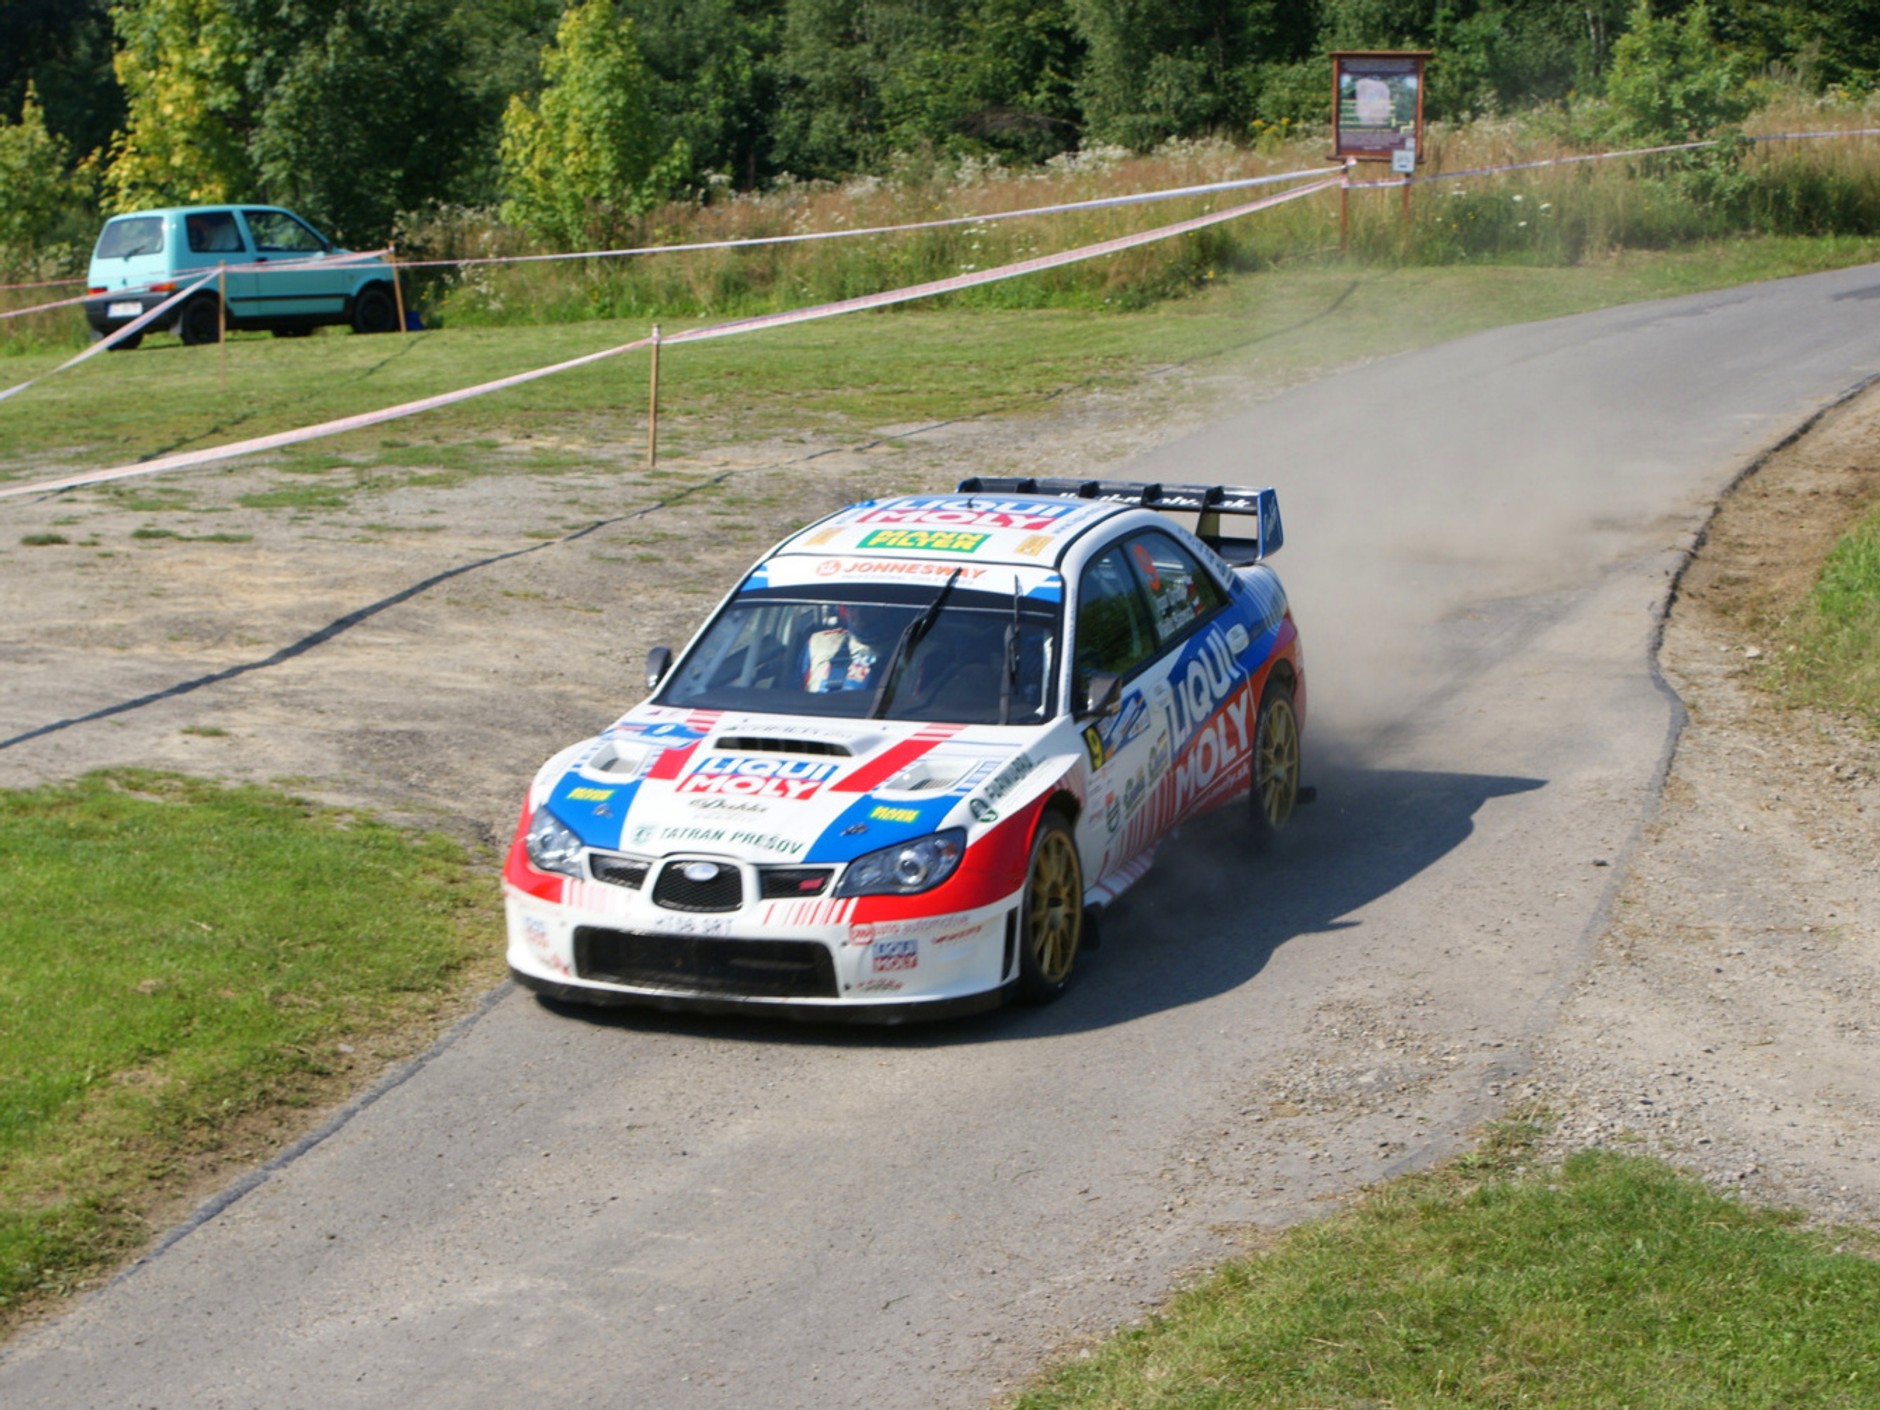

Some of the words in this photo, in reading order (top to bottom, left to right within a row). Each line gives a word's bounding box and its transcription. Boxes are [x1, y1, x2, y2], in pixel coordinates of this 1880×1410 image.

[873, 510, 1052, 529] MOLY
[893, 500, 1074, 518] LIQUI
[867, 538, 976, 551] FILTER
[876, 530, 985, 544] MANN
[841, 561, 987, 579] JONNESWAY
[1165, 628, 1241, 750] LIQUI
[1175, 689, 1249, 815] MOLY
[702, 757, 837, 781] LIQUI
[684, 774, 821, 800] MOLY
[660, 827, 726, 841] TATRAN
[730, 831, 804, 855] PREŠOV
